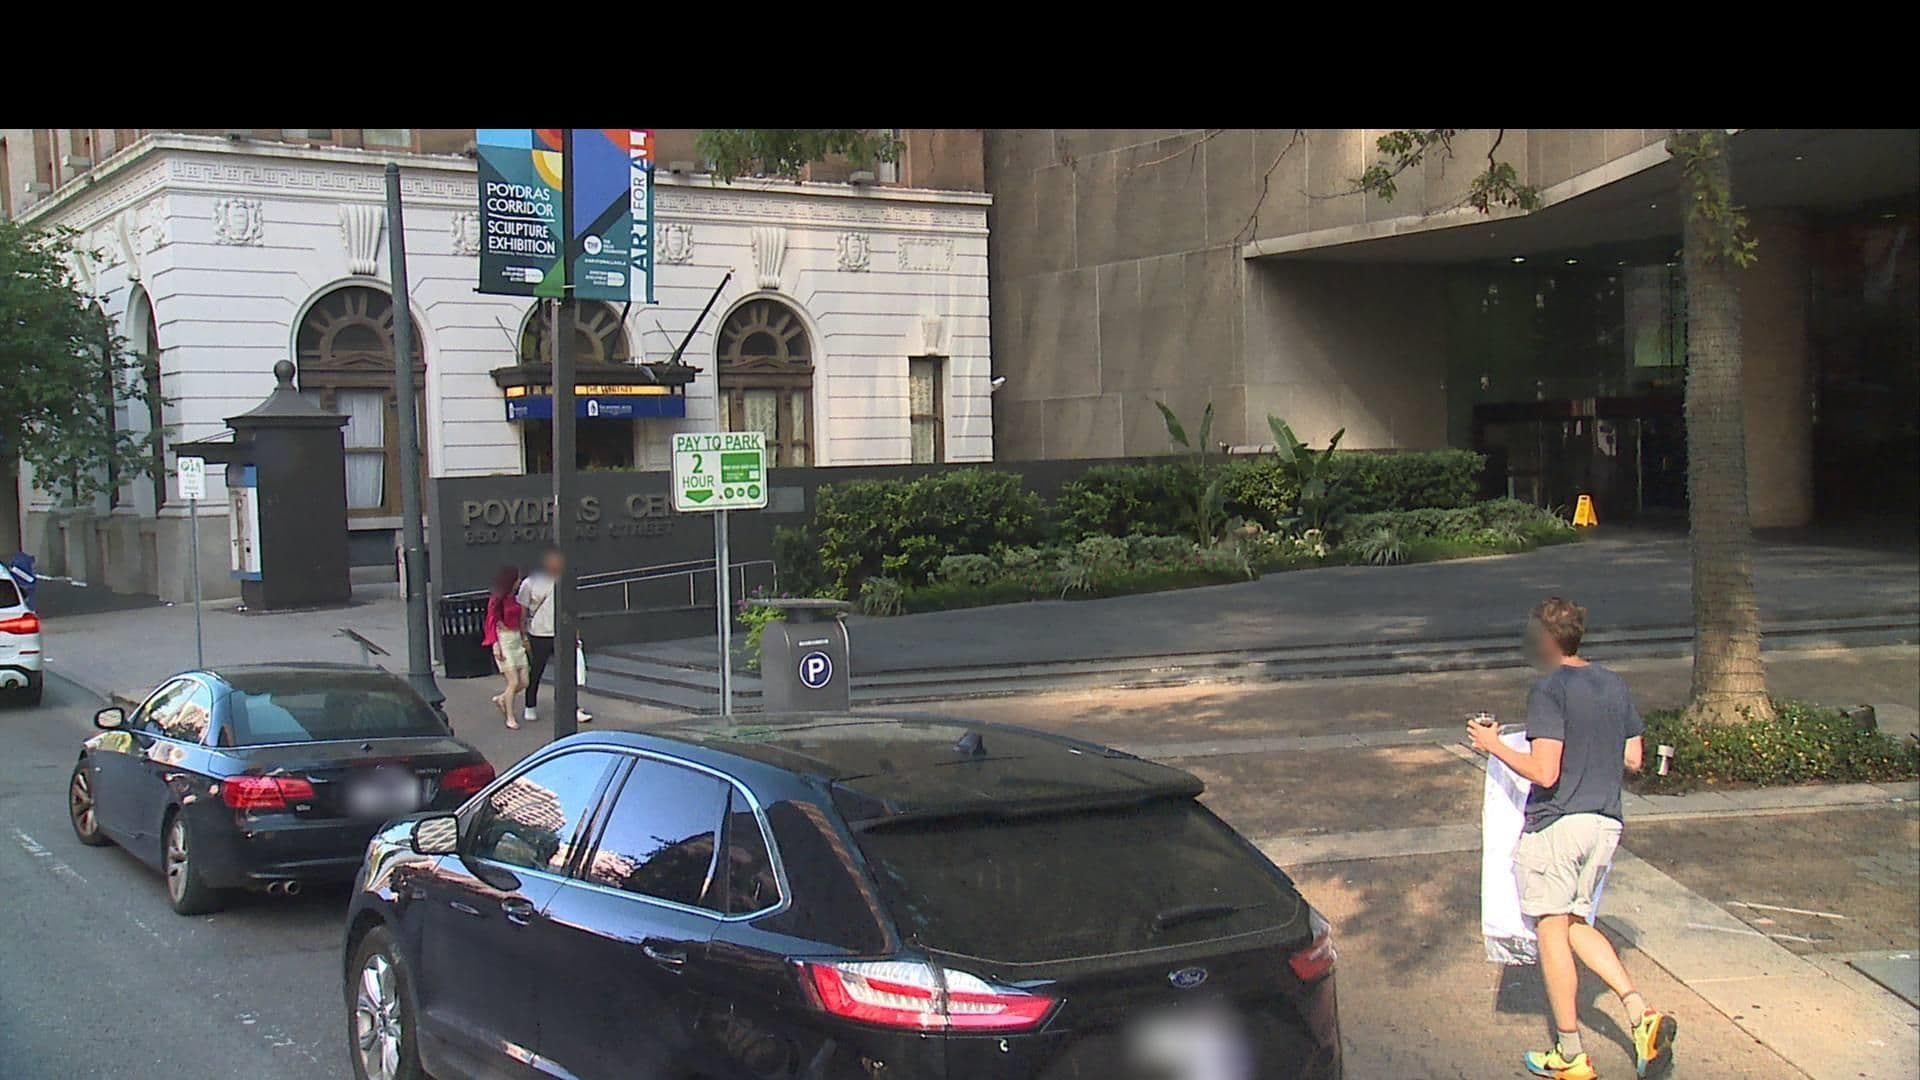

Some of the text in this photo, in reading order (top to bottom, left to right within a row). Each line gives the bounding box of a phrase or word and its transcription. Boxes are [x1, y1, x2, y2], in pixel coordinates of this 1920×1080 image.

[486, 182, 551, 201] POYDRAS
[633, 176, 645, 210] FOR
[486, 198, 554, 218] CORRIDOR
[487, 220, 550, 239] SCULPTURE
[488, 236, 556, 254] EXHIBITION
[630, 212, 648, 272] ART
[677, 434, 760, 452] PAY TO PARK
[691, 453, 704, 474] 2
[682, 474, 716, 488] HOUR
[808, 657, 825, 683] P
